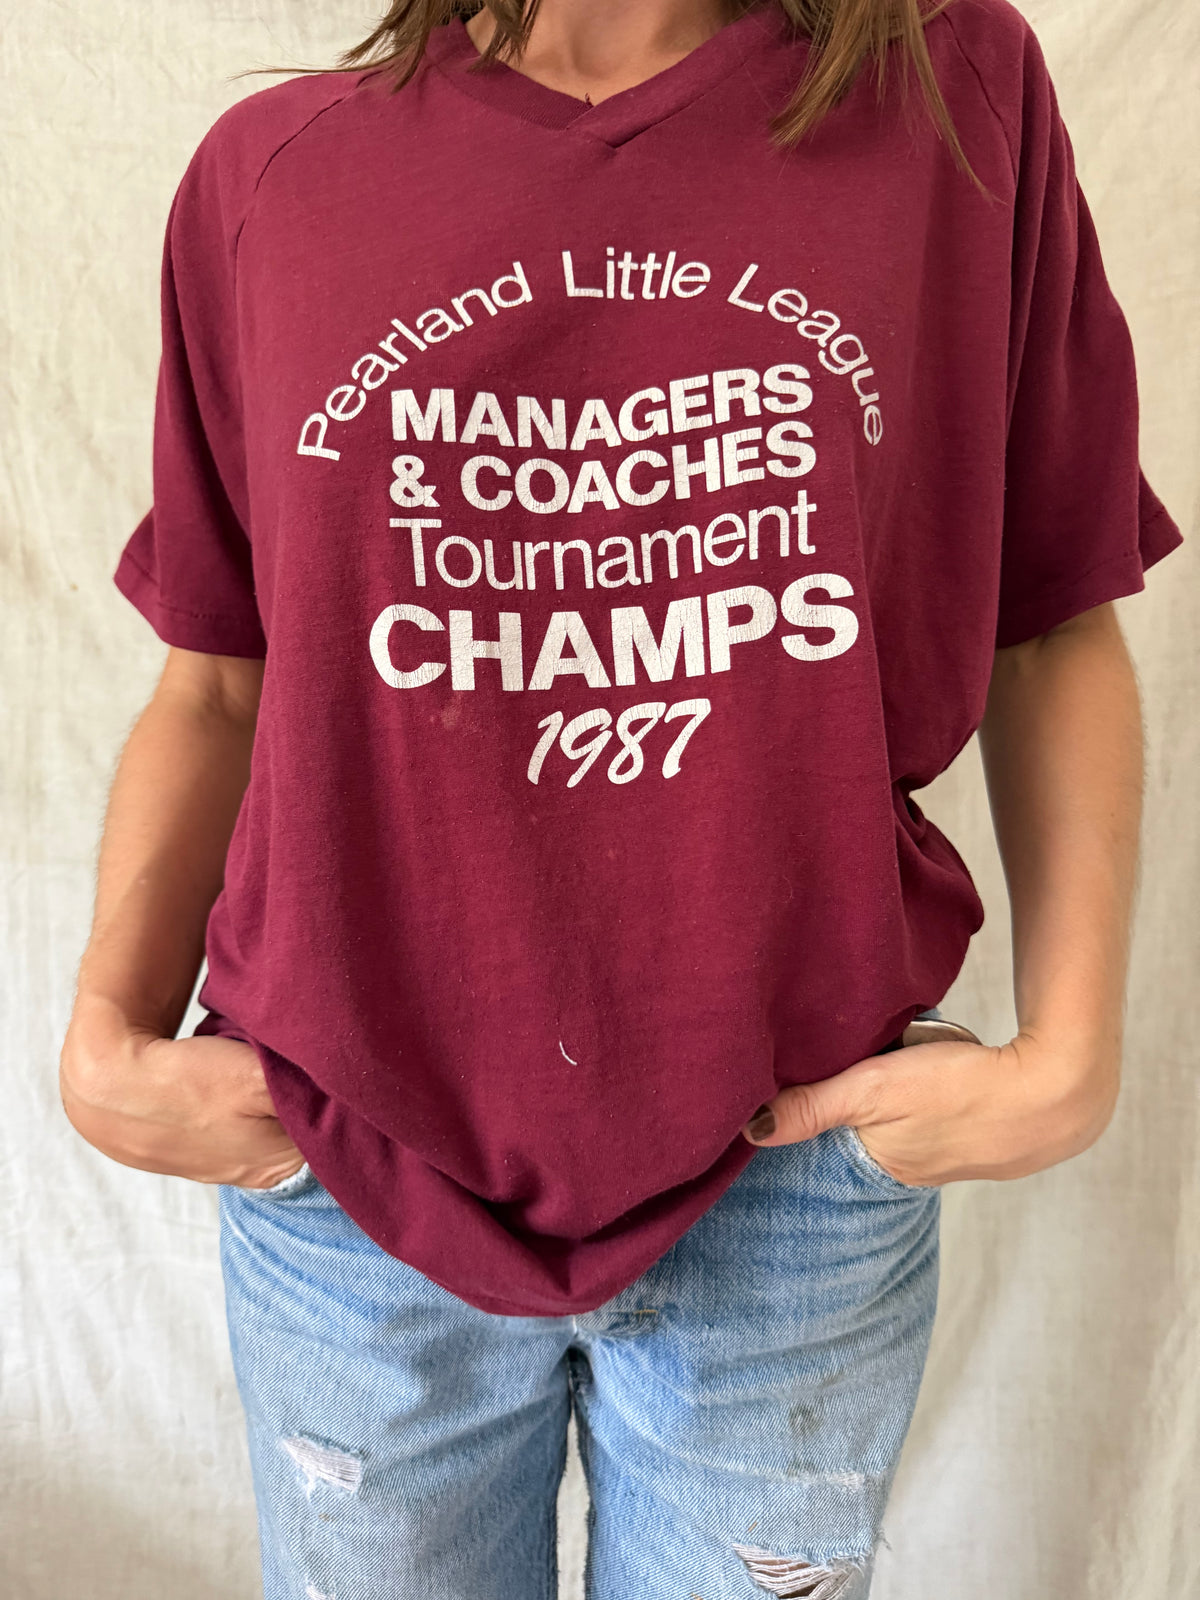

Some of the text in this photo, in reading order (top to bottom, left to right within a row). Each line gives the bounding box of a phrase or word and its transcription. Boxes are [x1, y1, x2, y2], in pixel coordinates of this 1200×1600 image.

[296, 246, 883, 462] Pearland Little League
[390, 363, 813, 451] MANAGERS
[389, 420, 817, 515] & COACHES
[389, 489, 818, 591] Tournament
[368, 572, 860, 692] CHAMPS
[527, 698, 712, 789] 1987
